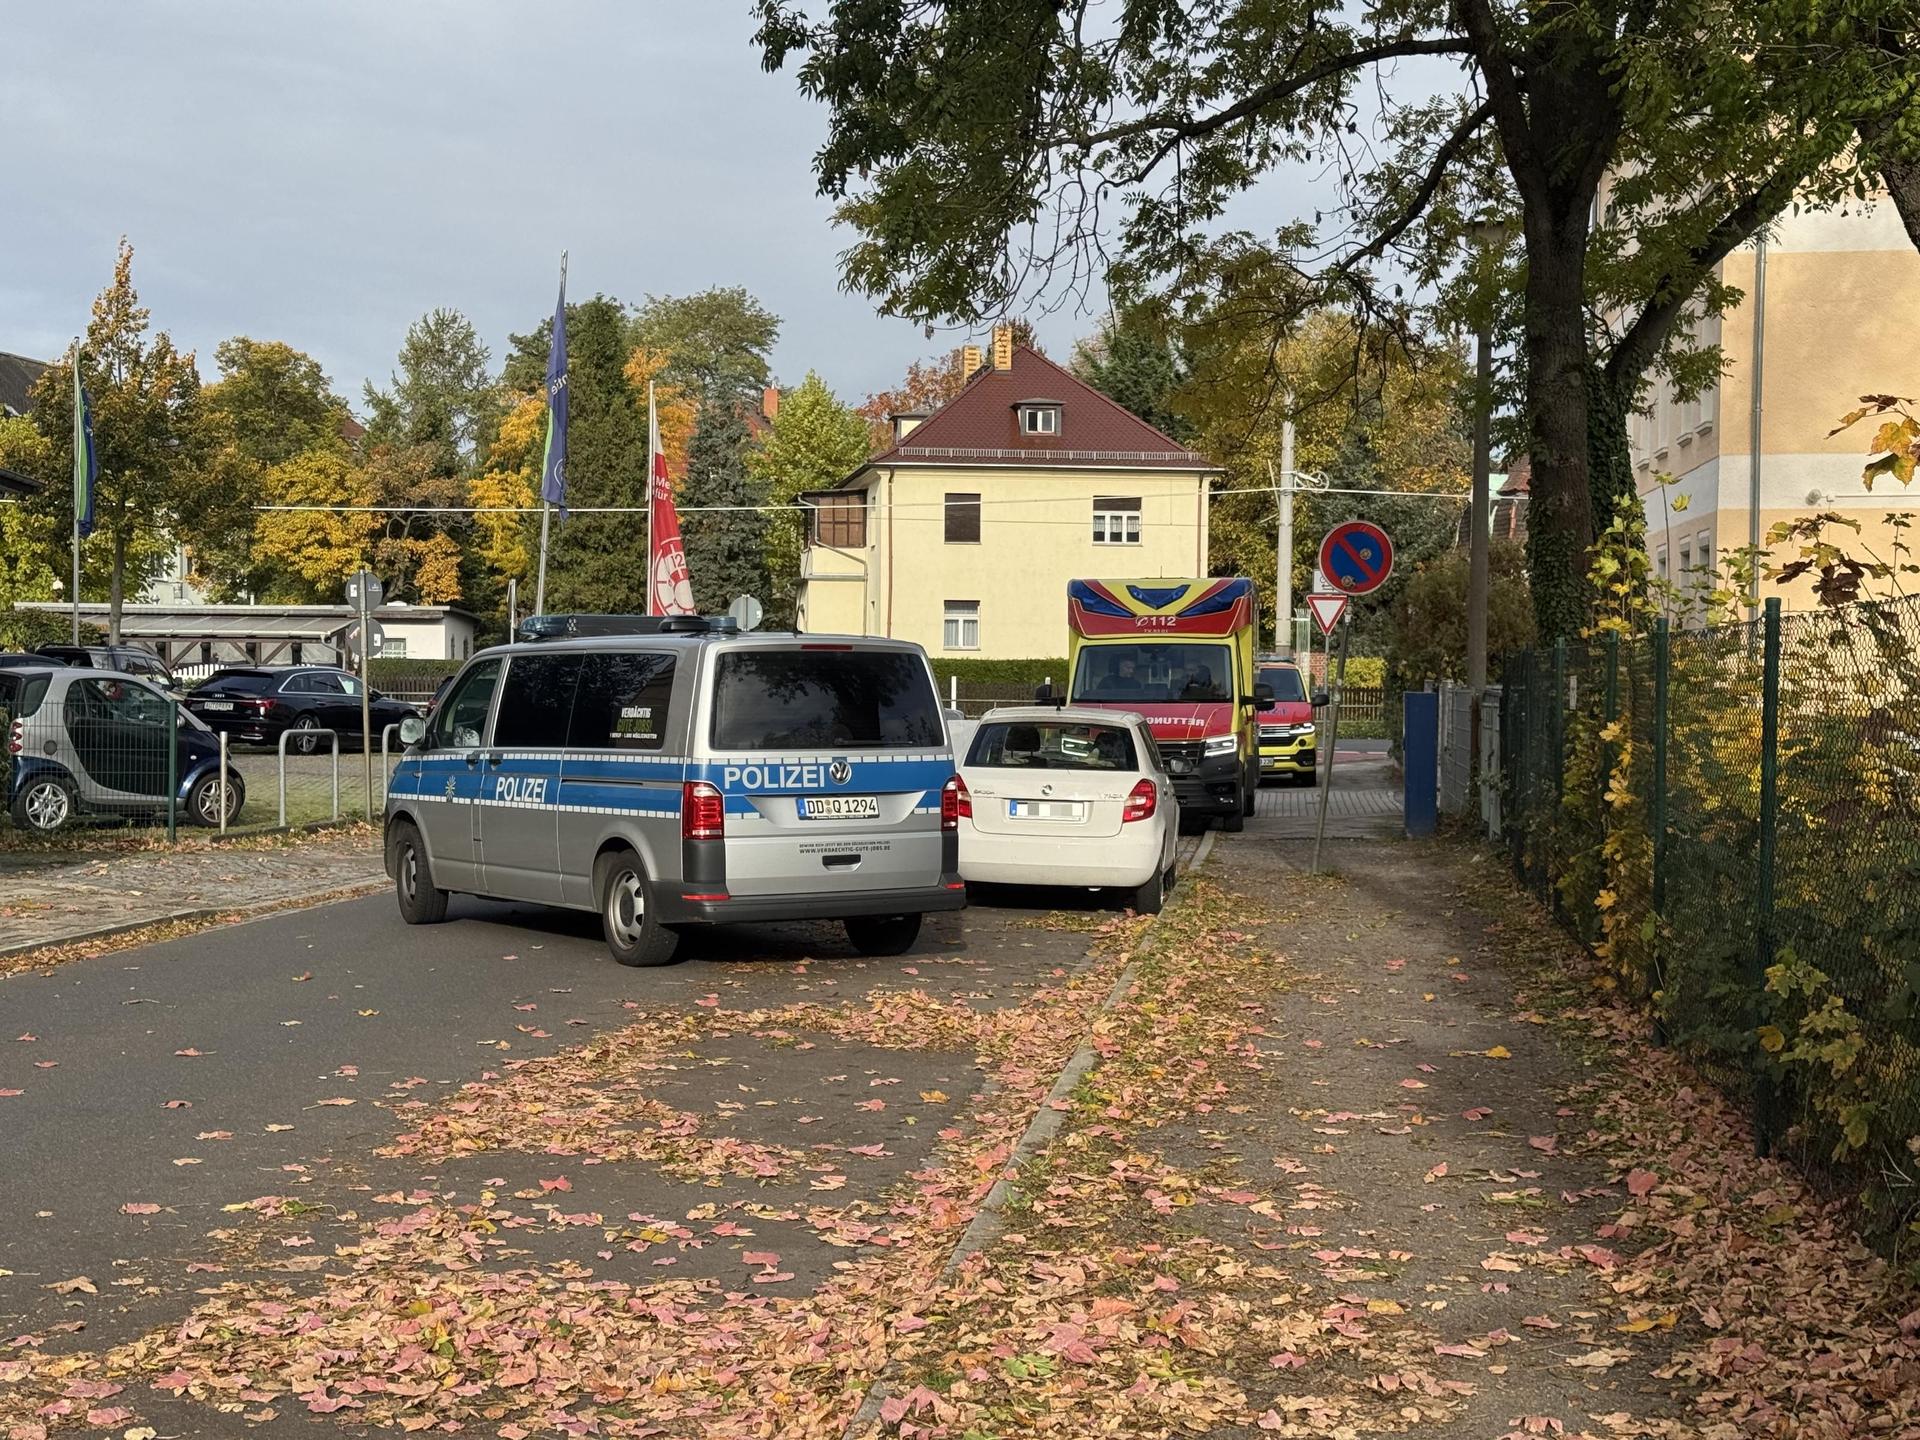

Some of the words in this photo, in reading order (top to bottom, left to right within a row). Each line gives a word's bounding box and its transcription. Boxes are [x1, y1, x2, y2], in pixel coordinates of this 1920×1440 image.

[1150, 616, 1176, 626] 112
[621, 705, 652, 719] VERDÄCHTIG
[617, 719, 633, 732] GUTE
[724, 766, 825, 789] POLIZEI
[495, 776, 548, 803] POLIZEI
[806, 800, 825, 813] DD
[833, 800, 841, 813] Q
[844, 799, 877, 813] 1294
